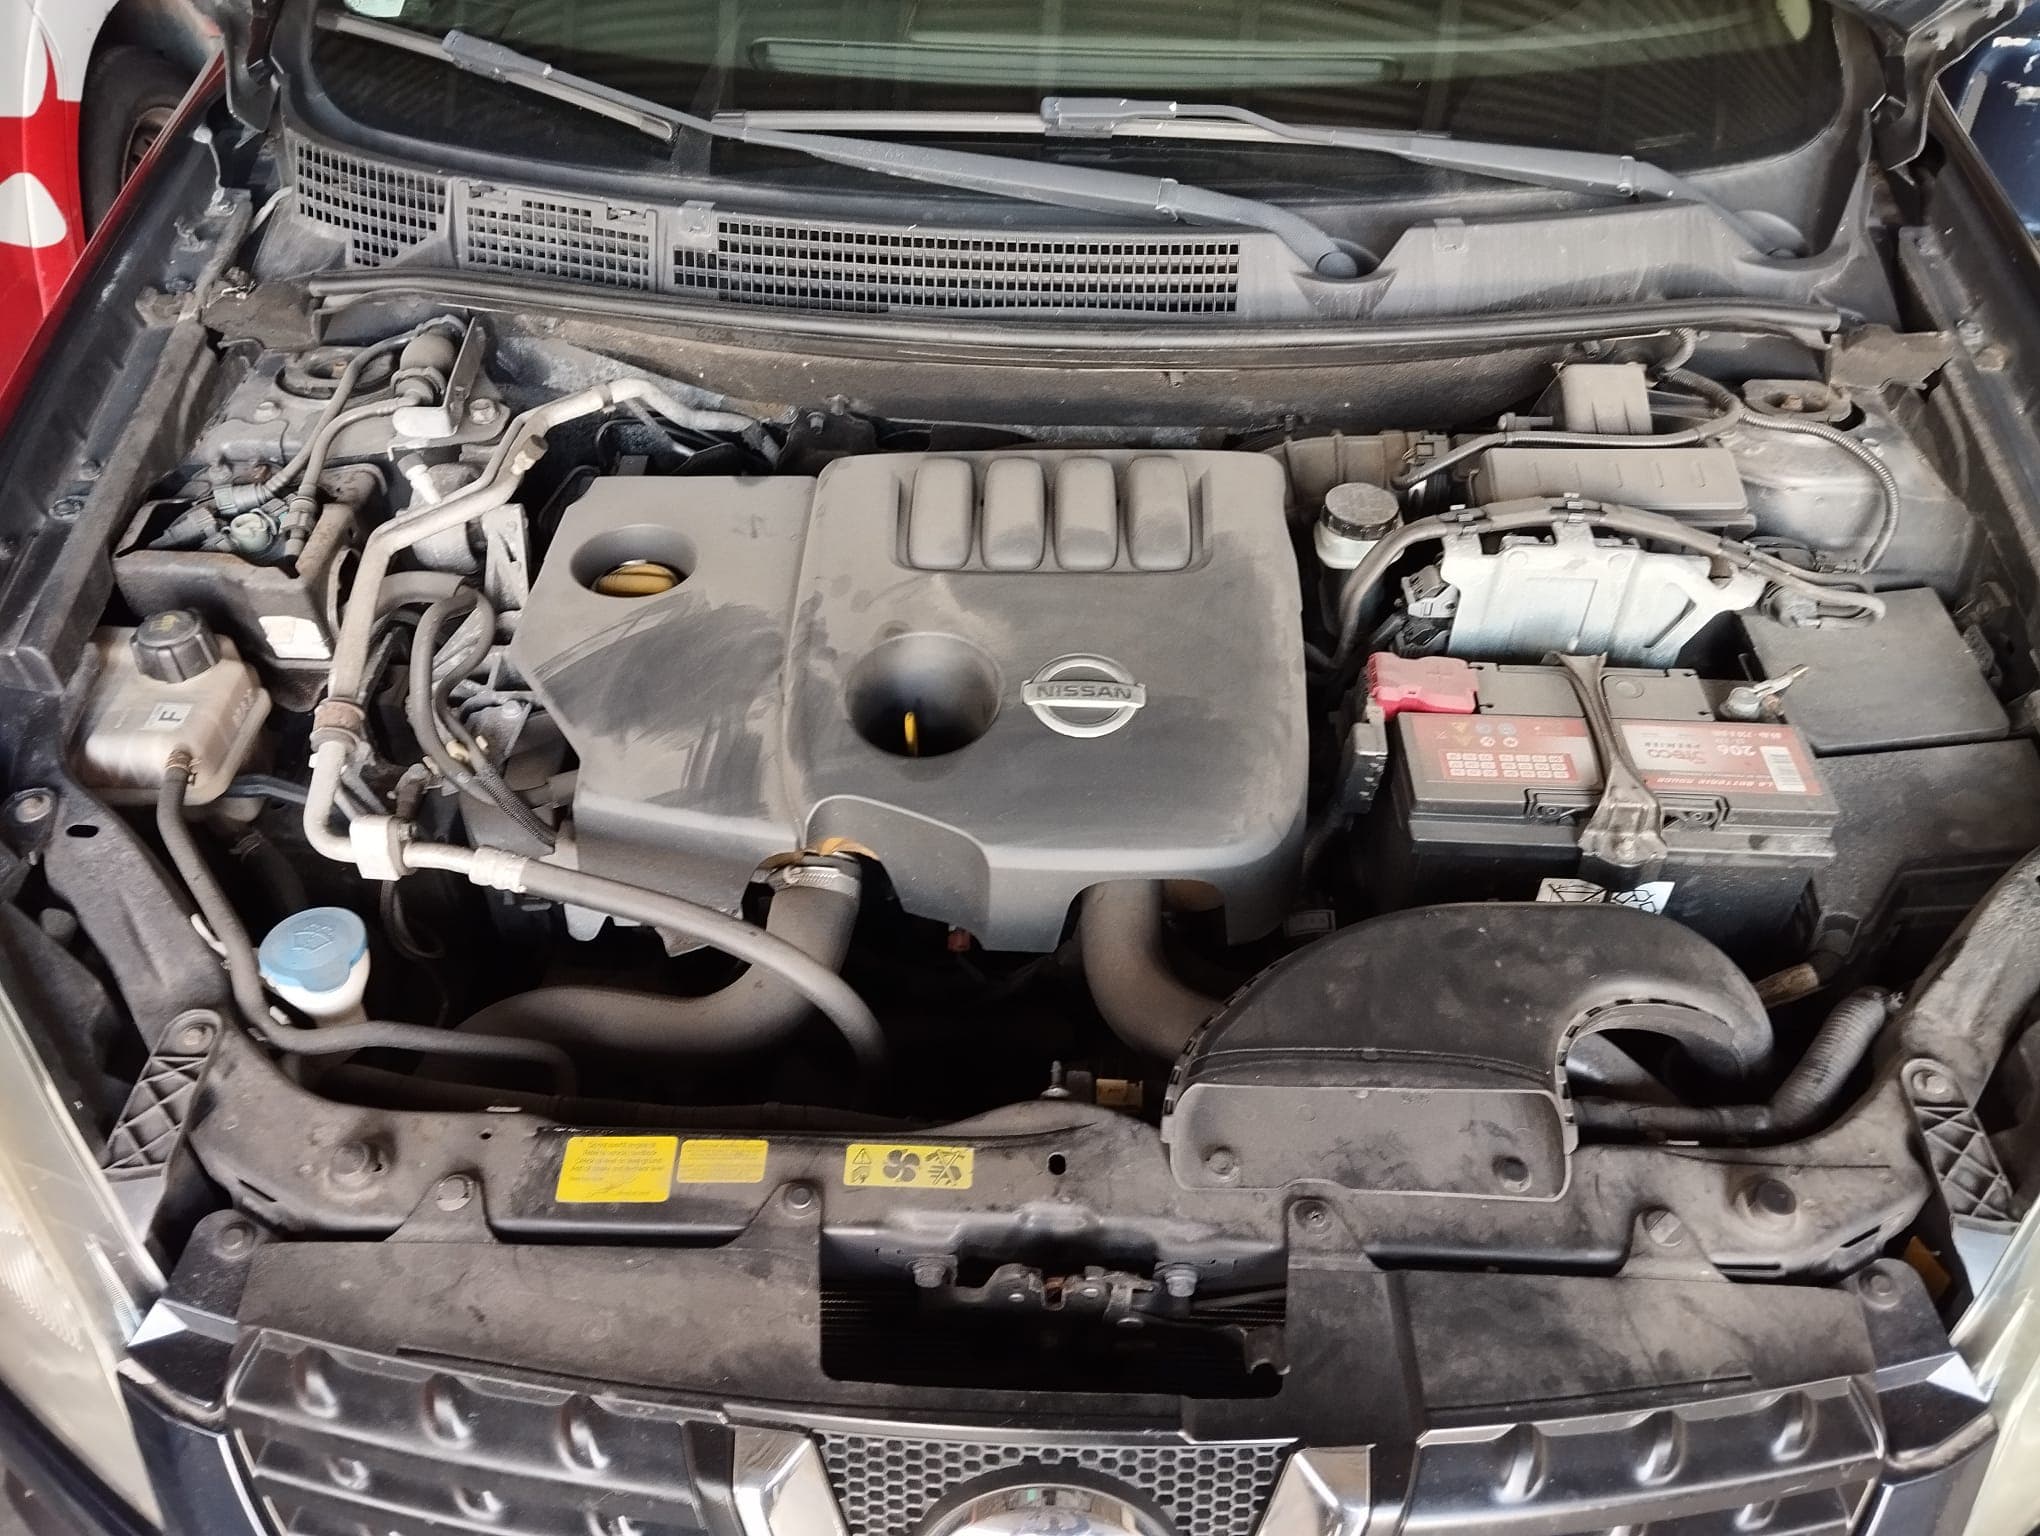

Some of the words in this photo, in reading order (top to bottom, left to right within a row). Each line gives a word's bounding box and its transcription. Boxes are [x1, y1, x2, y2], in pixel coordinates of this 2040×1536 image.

[1036, 685, 1132, 699] NISSAN
[158, 711, 182, 722] F
[1717, 745, 1757, 756] 206
